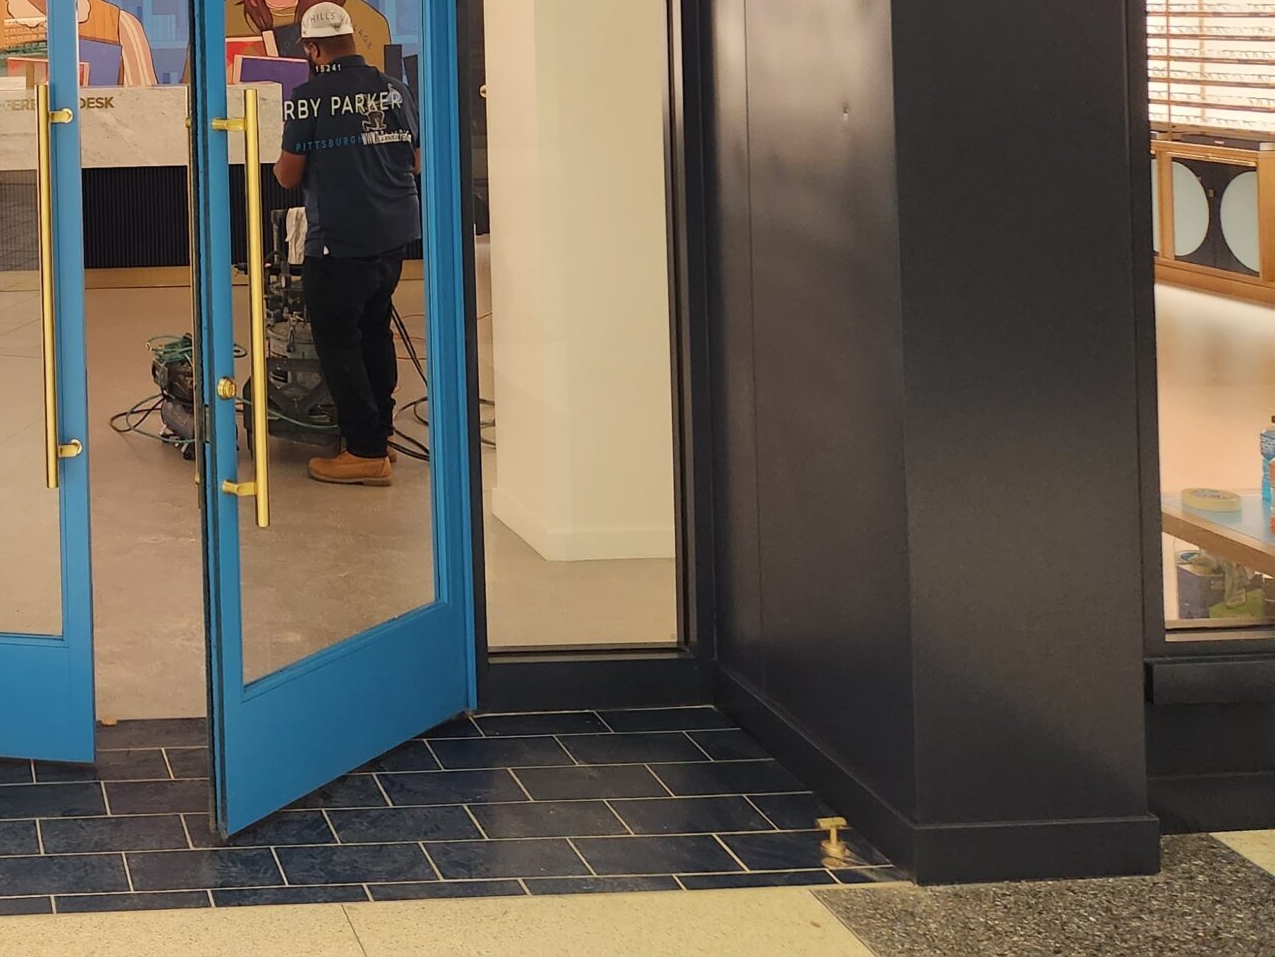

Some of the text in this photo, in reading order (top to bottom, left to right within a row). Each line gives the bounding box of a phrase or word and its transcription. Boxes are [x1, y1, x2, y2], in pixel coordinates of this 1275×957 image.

[310, 11, 337, 24] HILLS
[315, 63, 342, 73] 15241
[331, 90, 402, 117] PARKER
